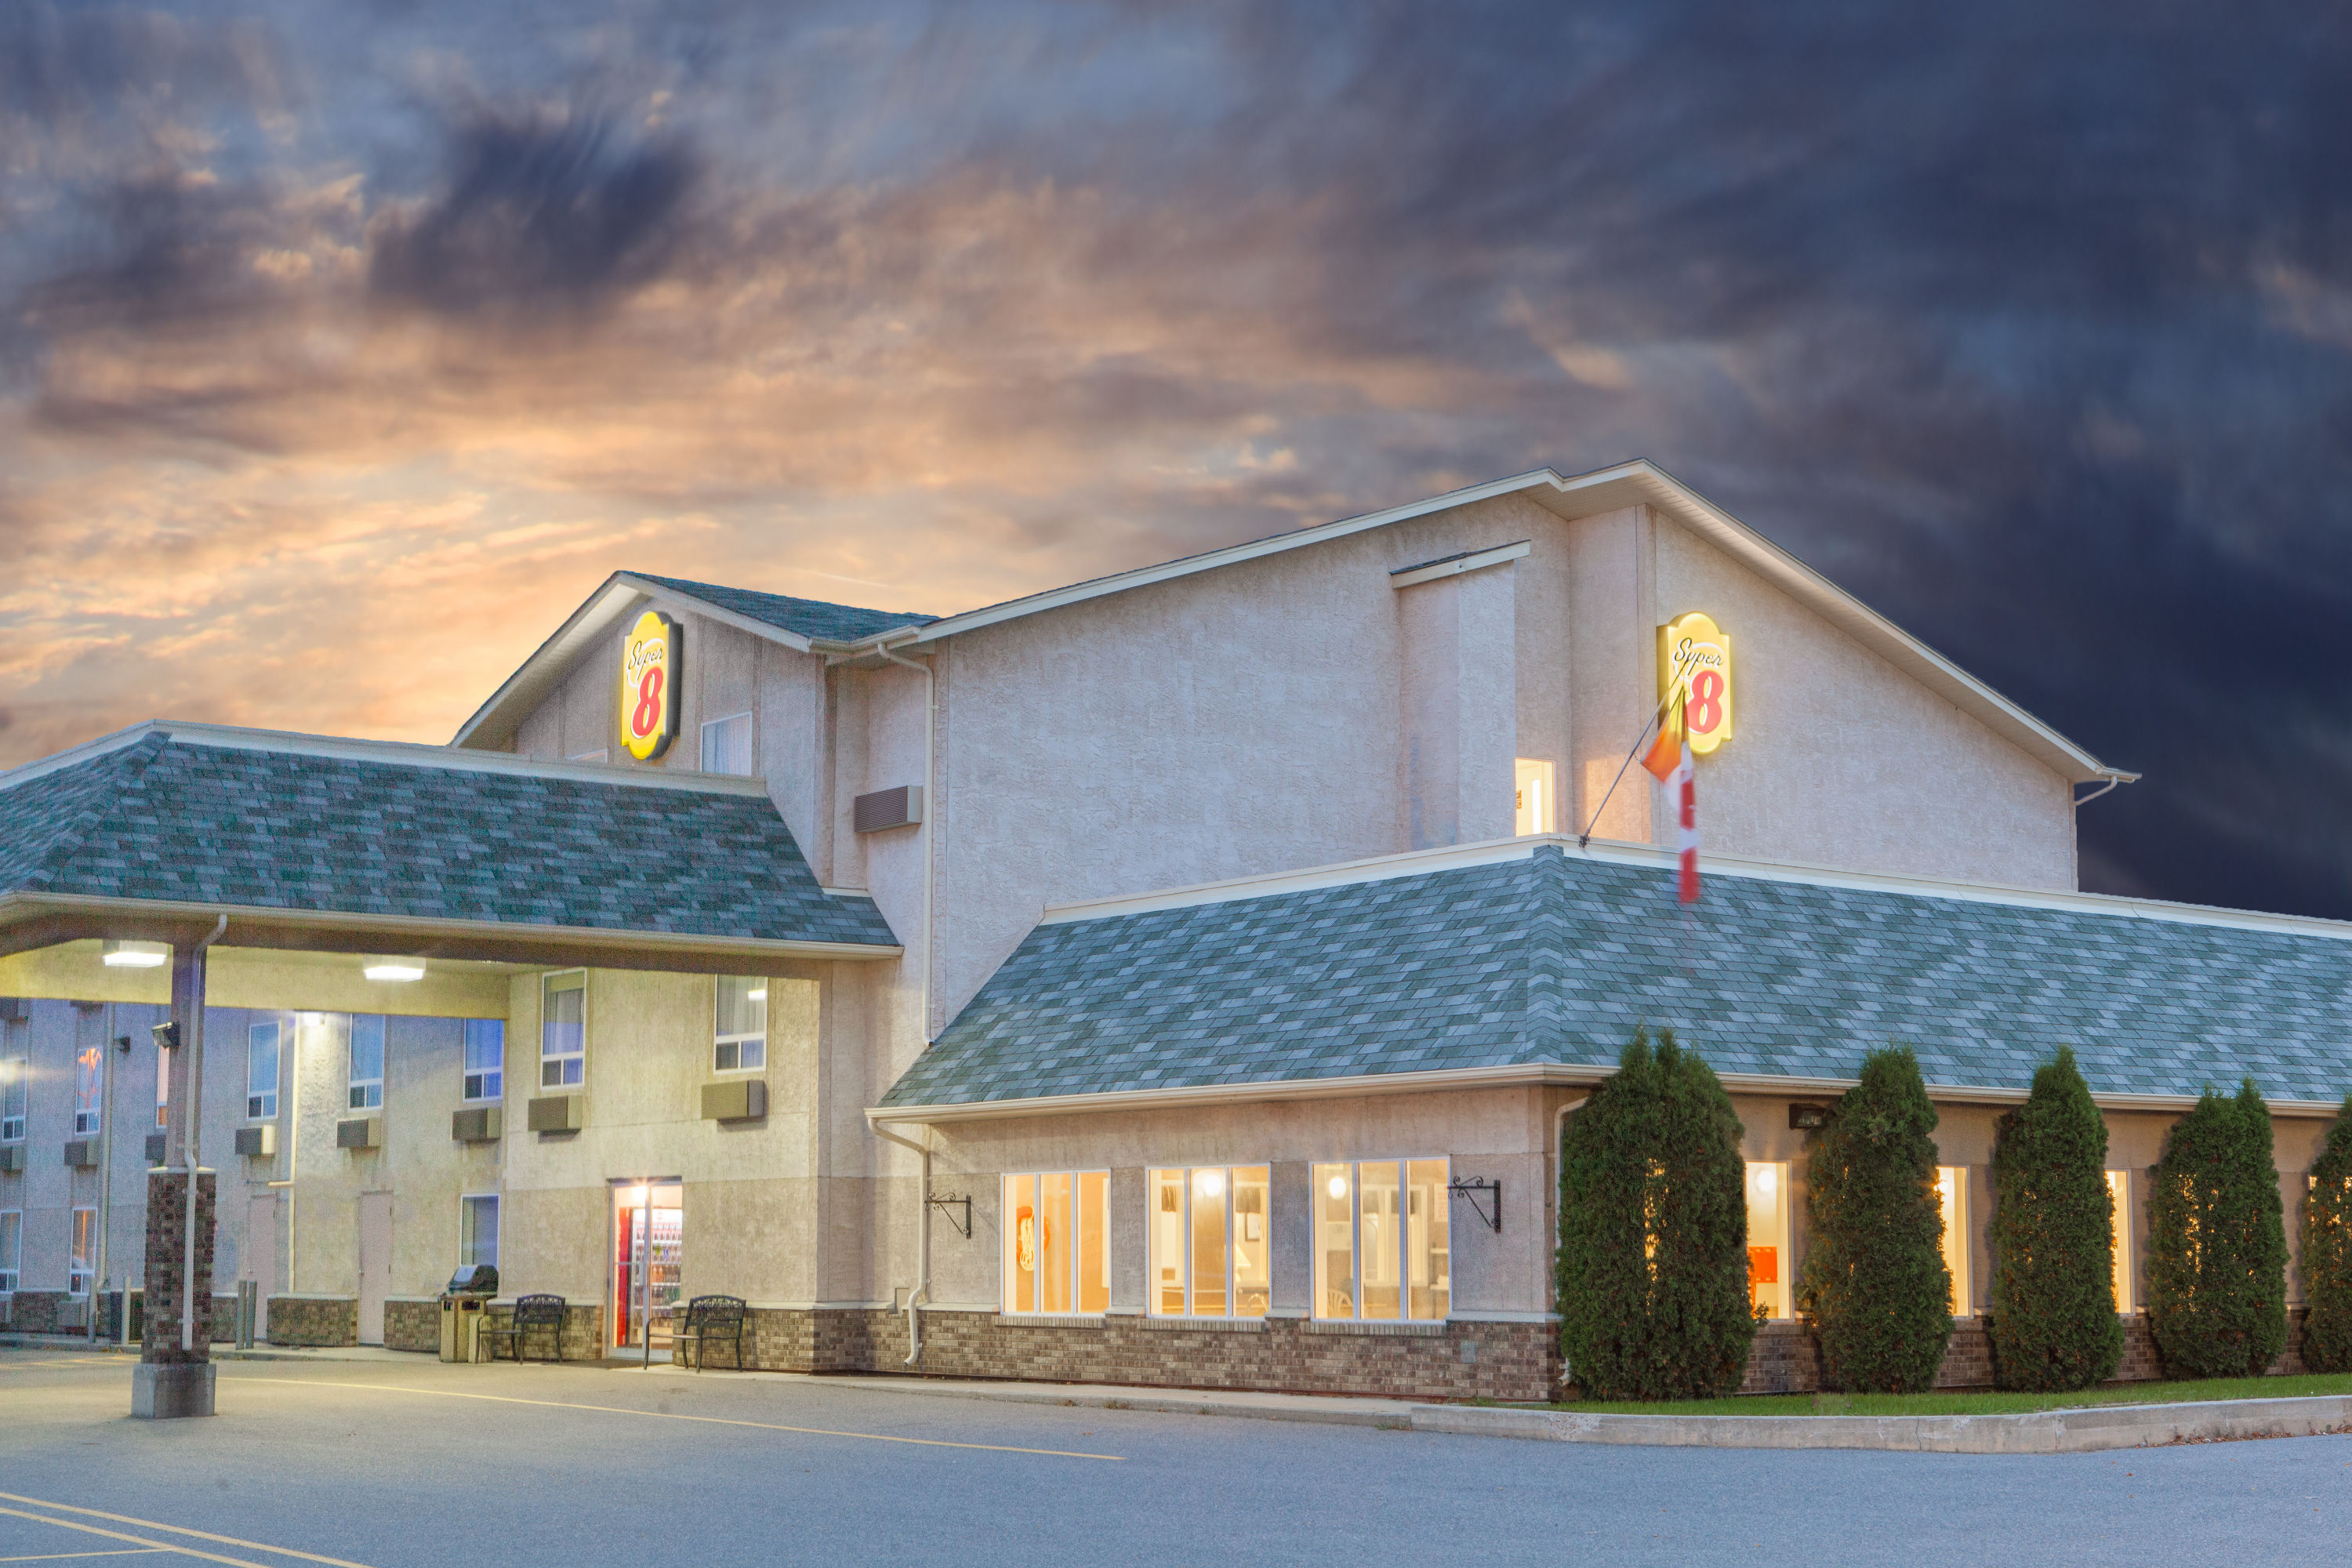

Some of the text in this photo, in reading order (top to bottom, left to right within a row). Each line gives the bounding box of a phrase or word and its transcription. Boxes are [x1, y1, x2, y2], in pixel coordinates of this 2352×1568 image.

[628, 640, 664, 682] Super
[1674, 637, 1724, 676] Super
[631, 666, 663, 739] 8
[1686, 670, 1725, 735] 8
